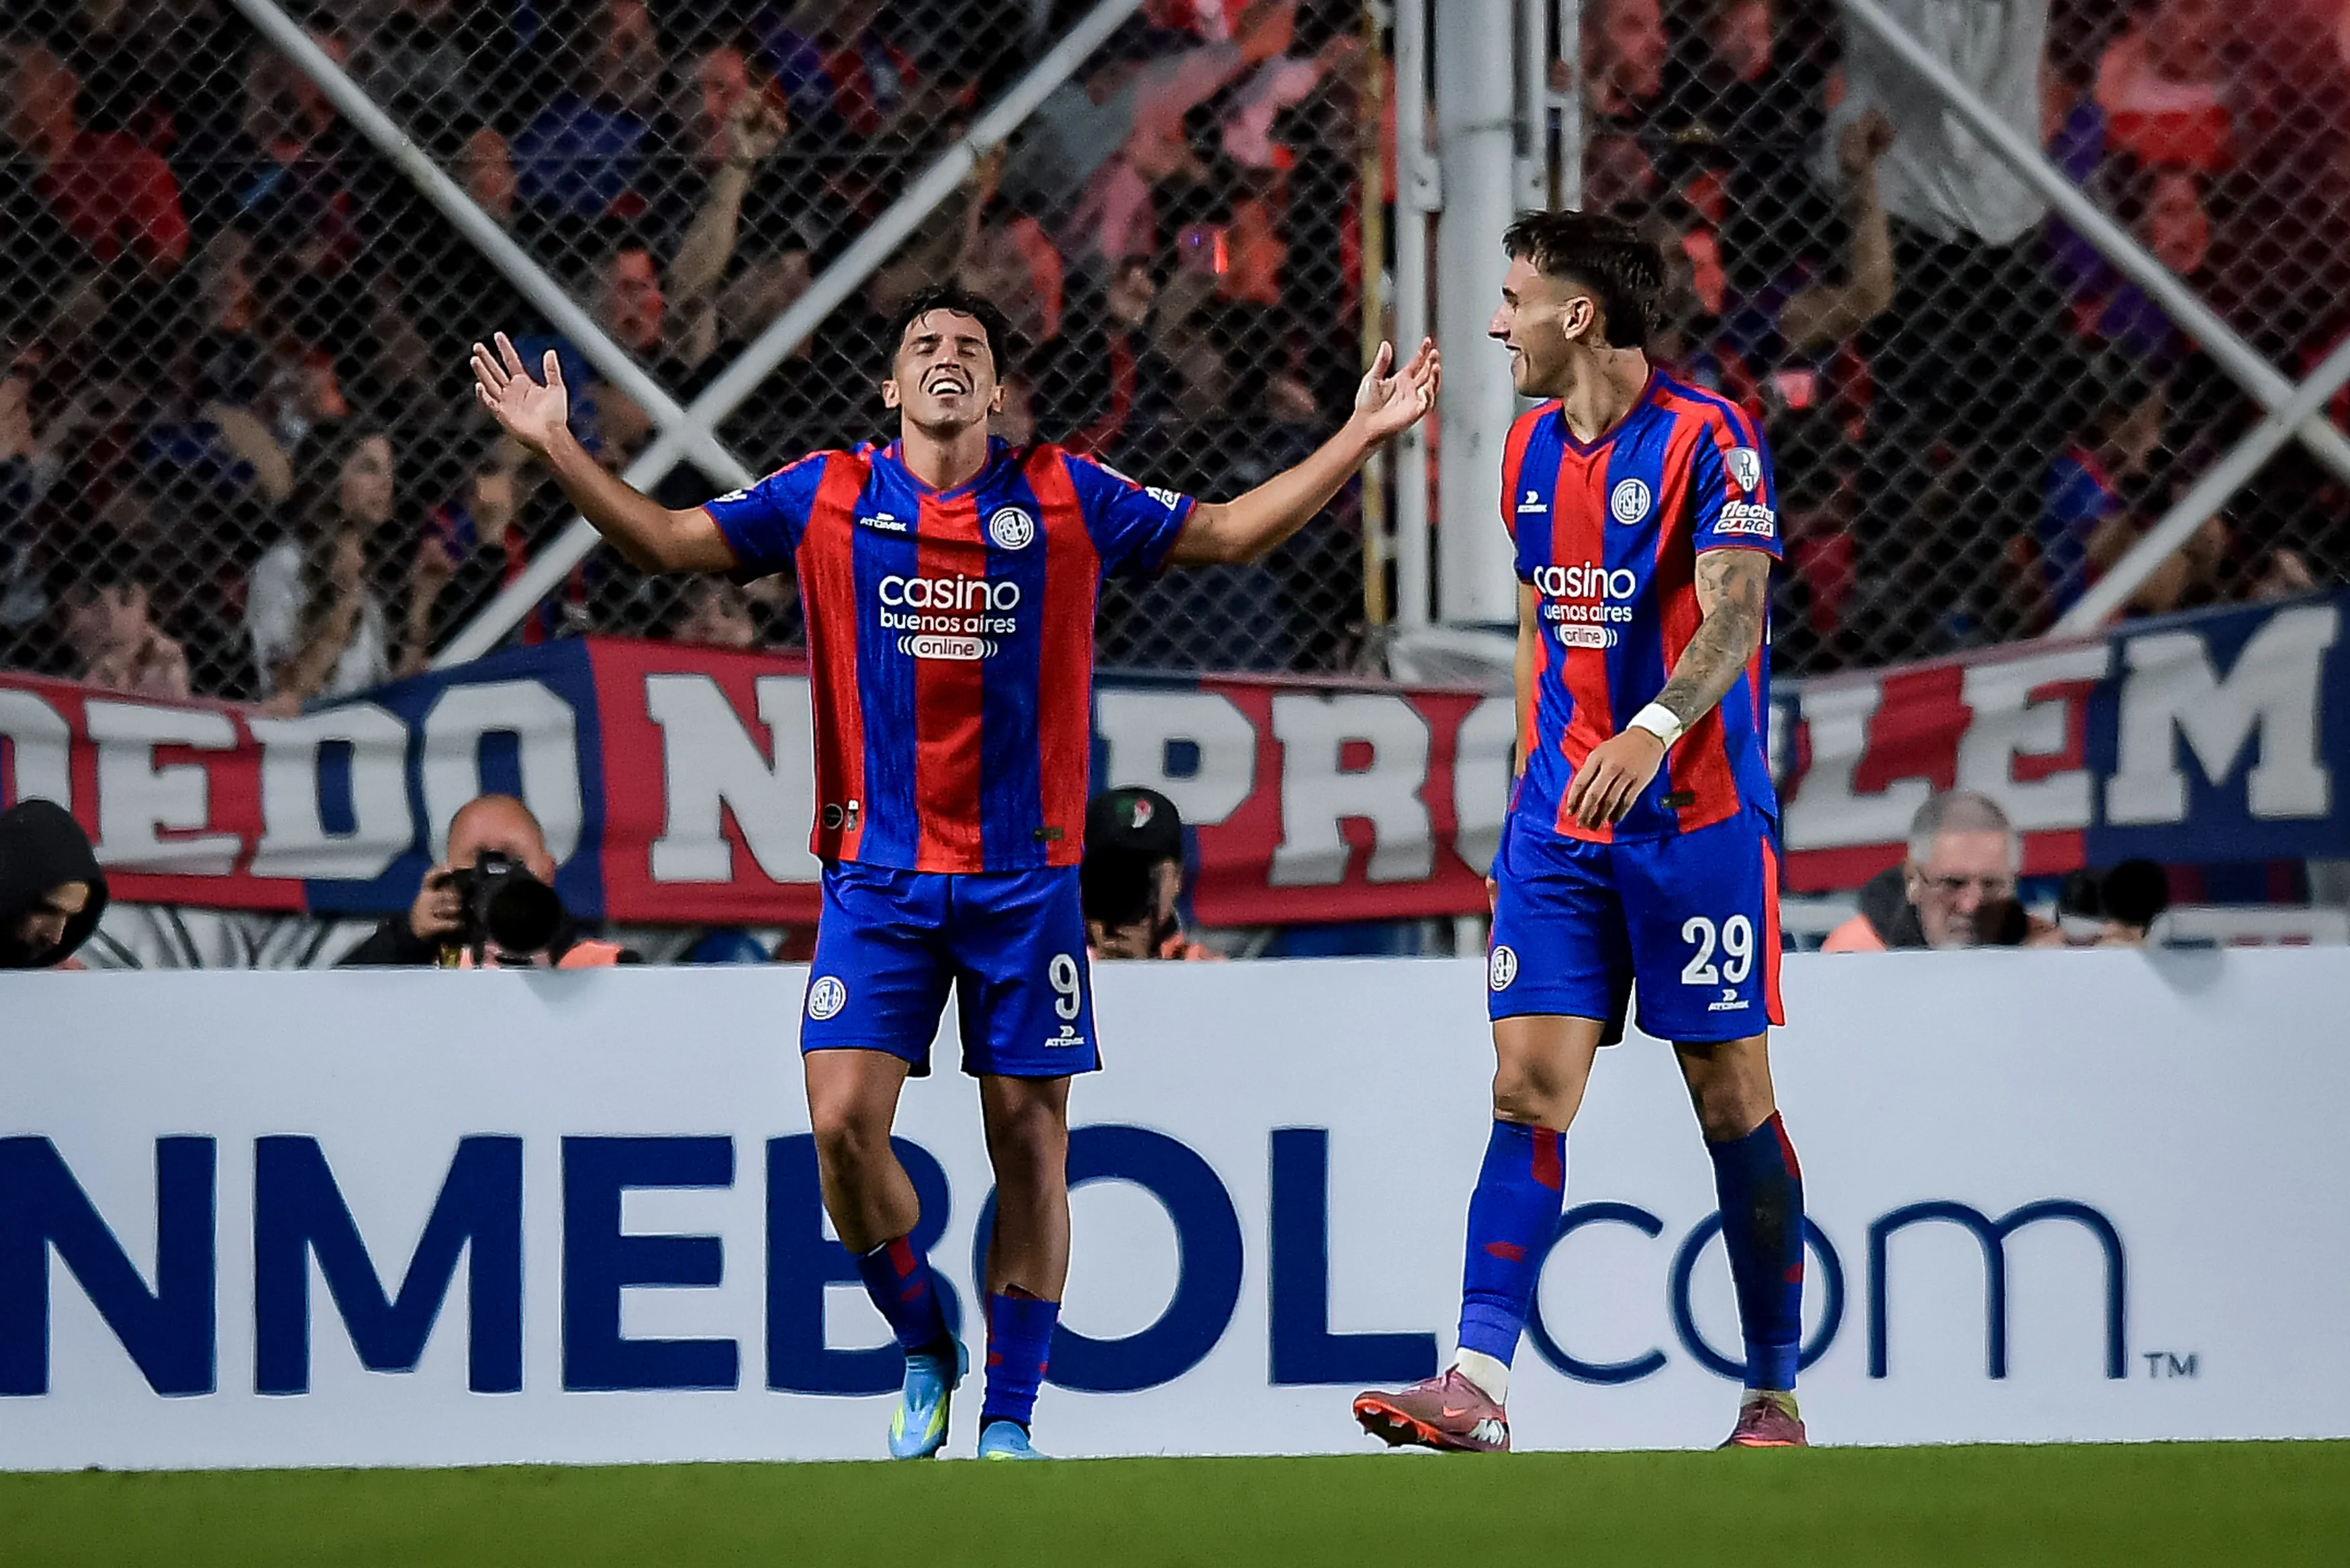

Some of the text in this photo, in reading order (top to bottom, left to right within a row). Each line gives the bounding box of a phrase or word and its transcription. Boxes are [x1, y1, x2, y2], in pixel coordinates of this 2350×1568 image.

[1717, 519, 1771, 534] CARGA
[878, 573, 1021, 610] casino
[1534, 561, 1636, 599] casino
[880, 606, 1017, 633] buenos aires
[1544, 601, 1633, 622] uenos aires
[919, 638, 975, 656] online
[1096, 605, 2339, 886] PRLEM
[1681, 914, 1754, 985] 29
[1047, 953, 1081, 1020] 9
